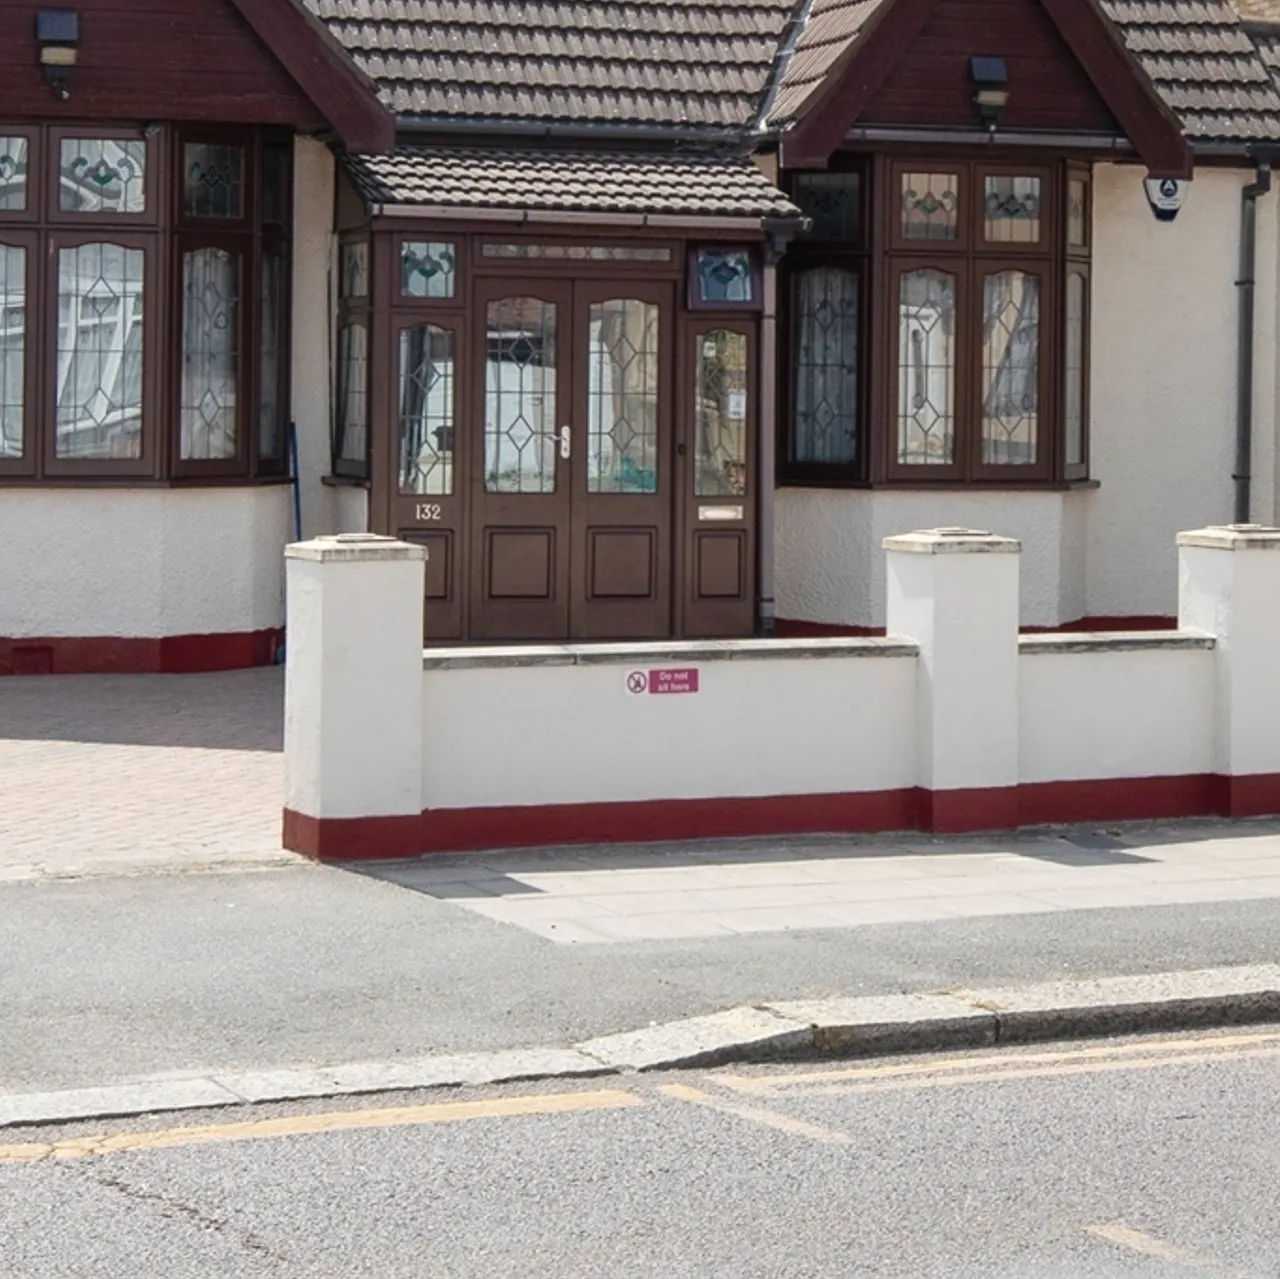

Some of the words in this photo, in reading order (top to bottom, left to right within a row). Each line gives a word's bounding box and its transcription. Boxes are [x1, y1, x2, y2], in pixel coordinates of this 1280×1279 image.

[415, 503, 441, 520] 132
[659, 672, 672, 680] Do
[674, 672, 688, 680] not
[658, 683, 669, 691] sit
[670, 683, 690, 691] here
